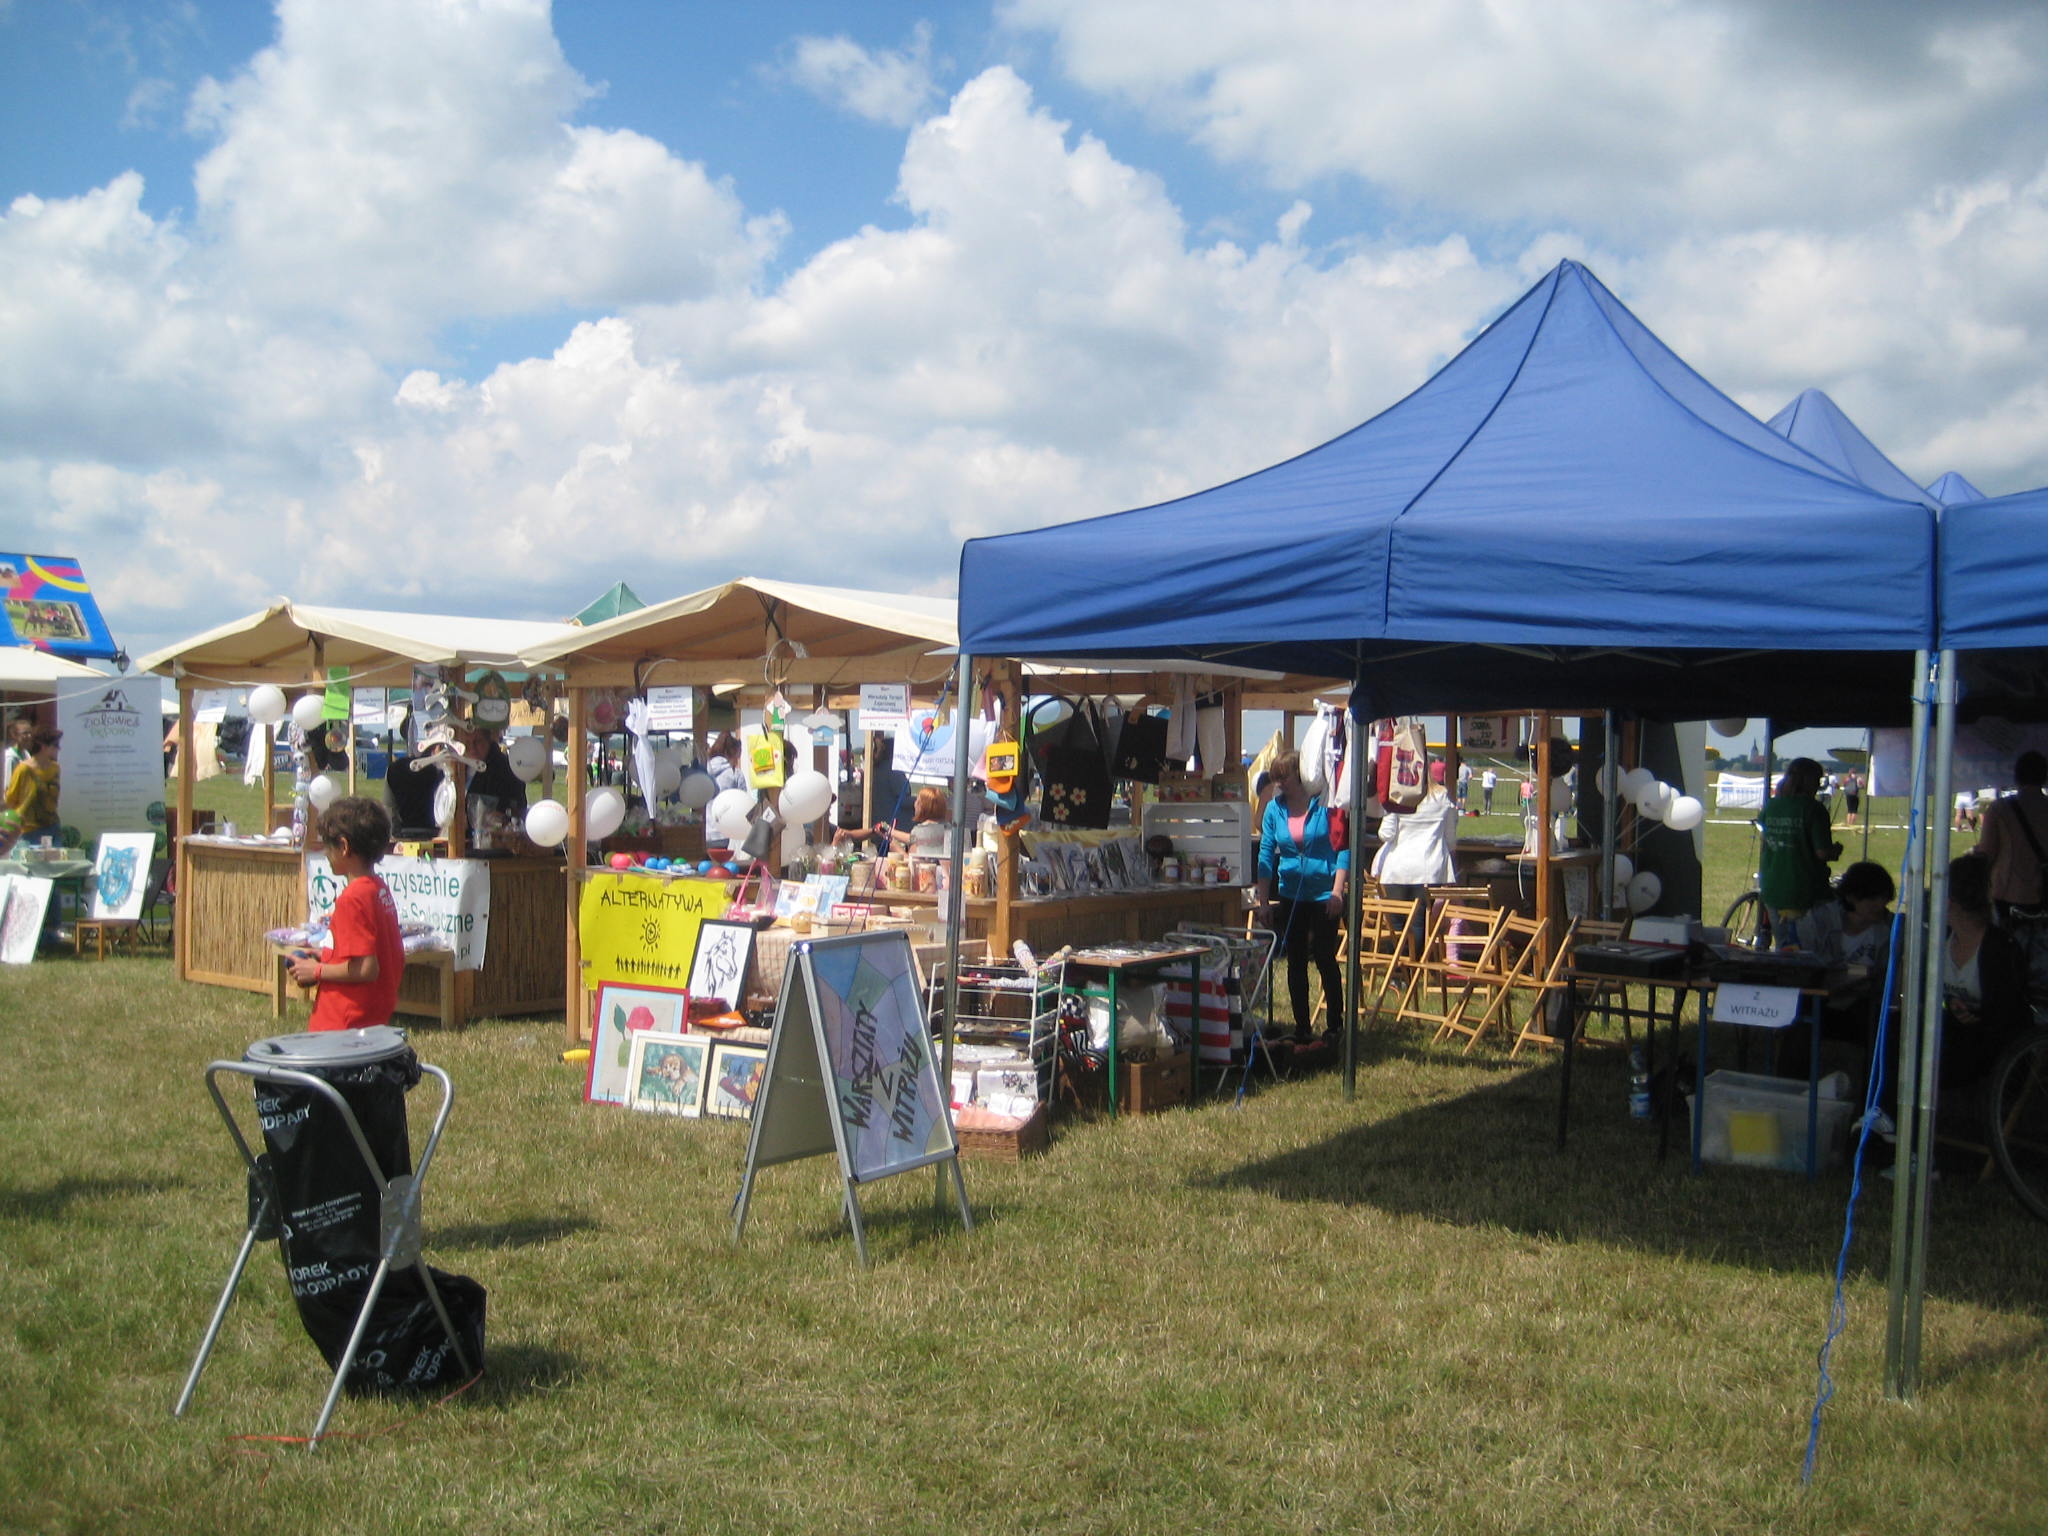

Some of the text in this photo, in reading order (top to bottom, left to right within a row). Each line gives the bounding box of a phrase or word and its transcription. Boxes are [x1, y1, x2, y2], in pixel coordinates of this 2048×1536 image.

[377, 869, 460, 898] rzyszenie
[600, 889, 703, 914] ALTERNATYWA
[1753, 991, 1761, 1001] Z
[843, 999, 878, 1129] WARSZTATY
[873, 1058, 893, 1100] Z
[256, 1097, 281, 1113] REK
[408, 1345, 432, 1380] REK
